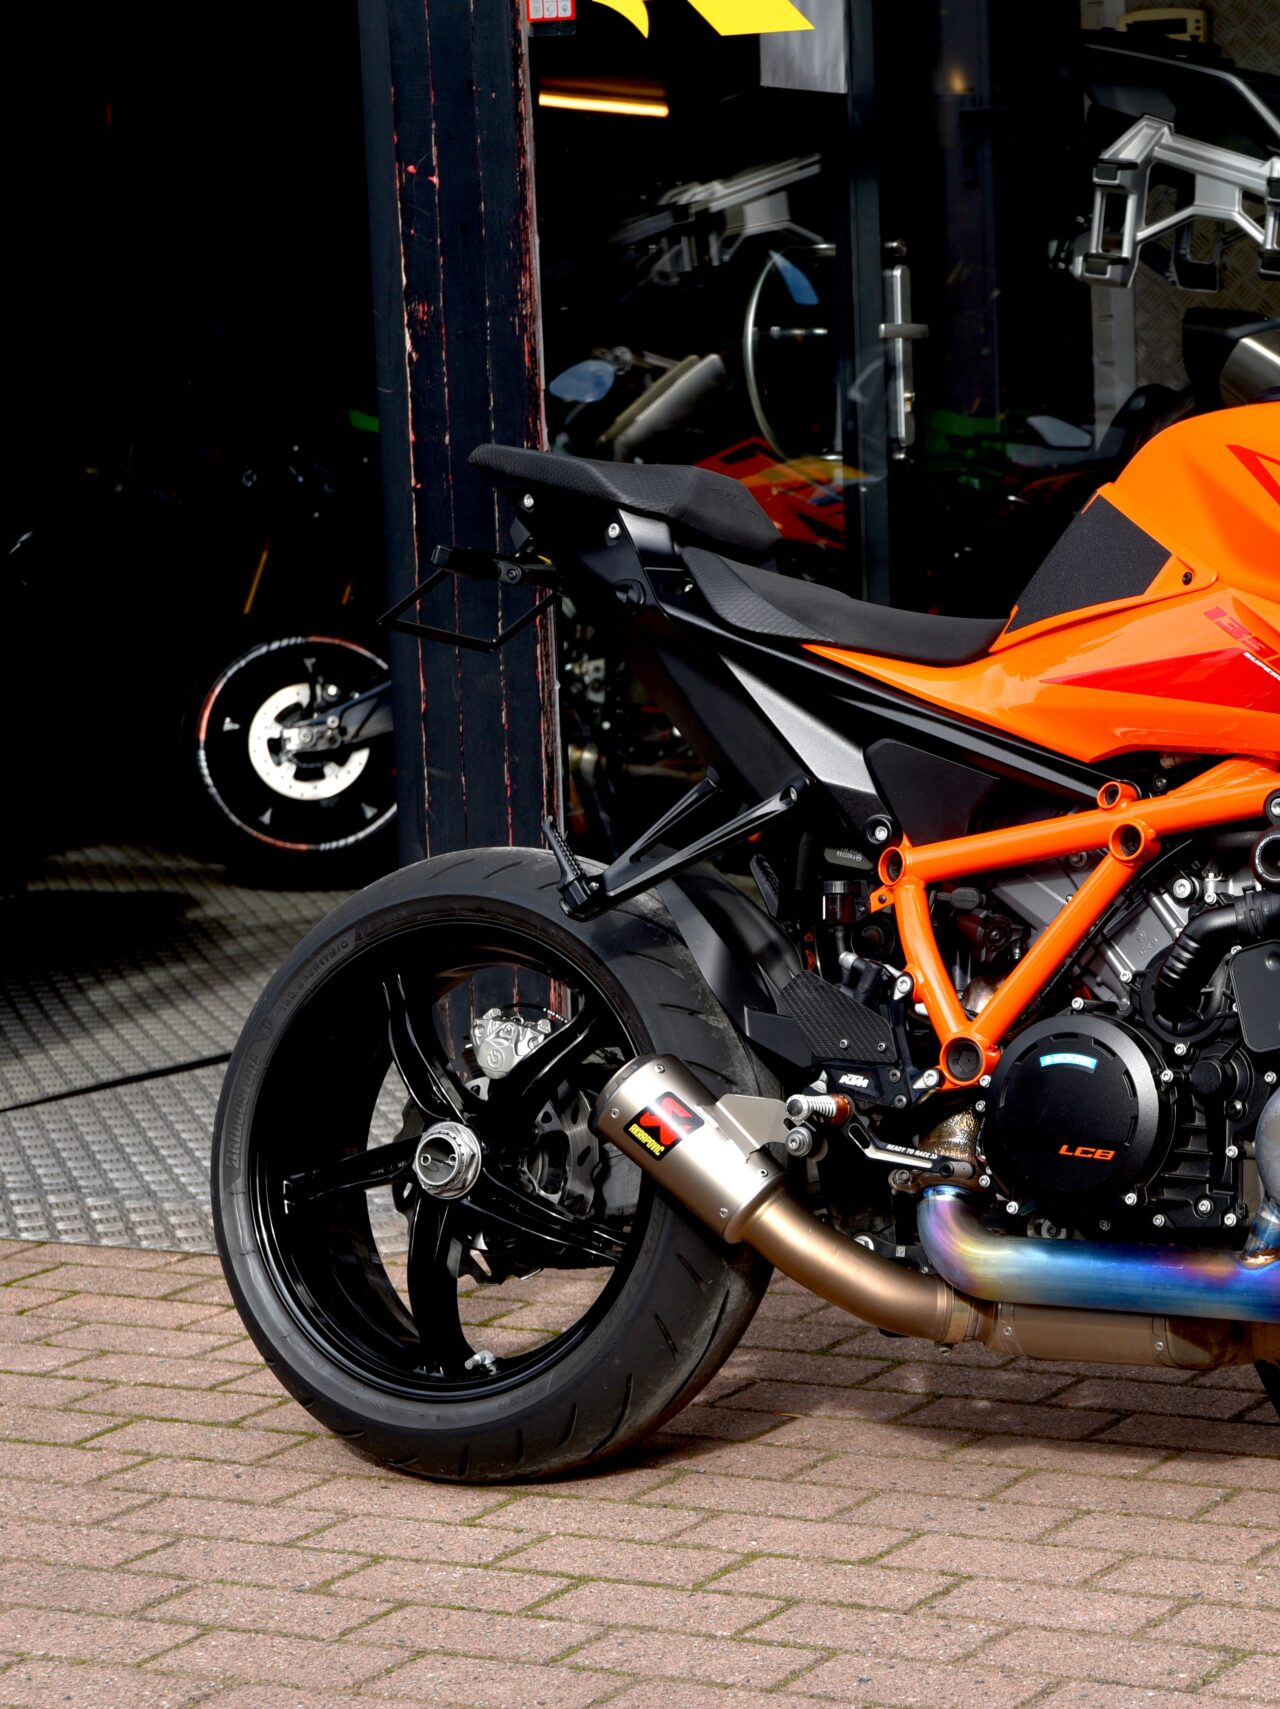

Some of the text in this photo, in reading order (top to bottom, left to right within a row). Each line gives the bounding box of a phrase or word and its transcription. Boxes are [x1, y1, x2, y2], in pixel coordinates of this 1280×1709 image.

[838, 1073, 870, 1089] KTM
[886, 1143, 907, 1153] READY
[914, 1149, 931, 1159] RACE
[1058, 1144, 1116, 1161] LC8
